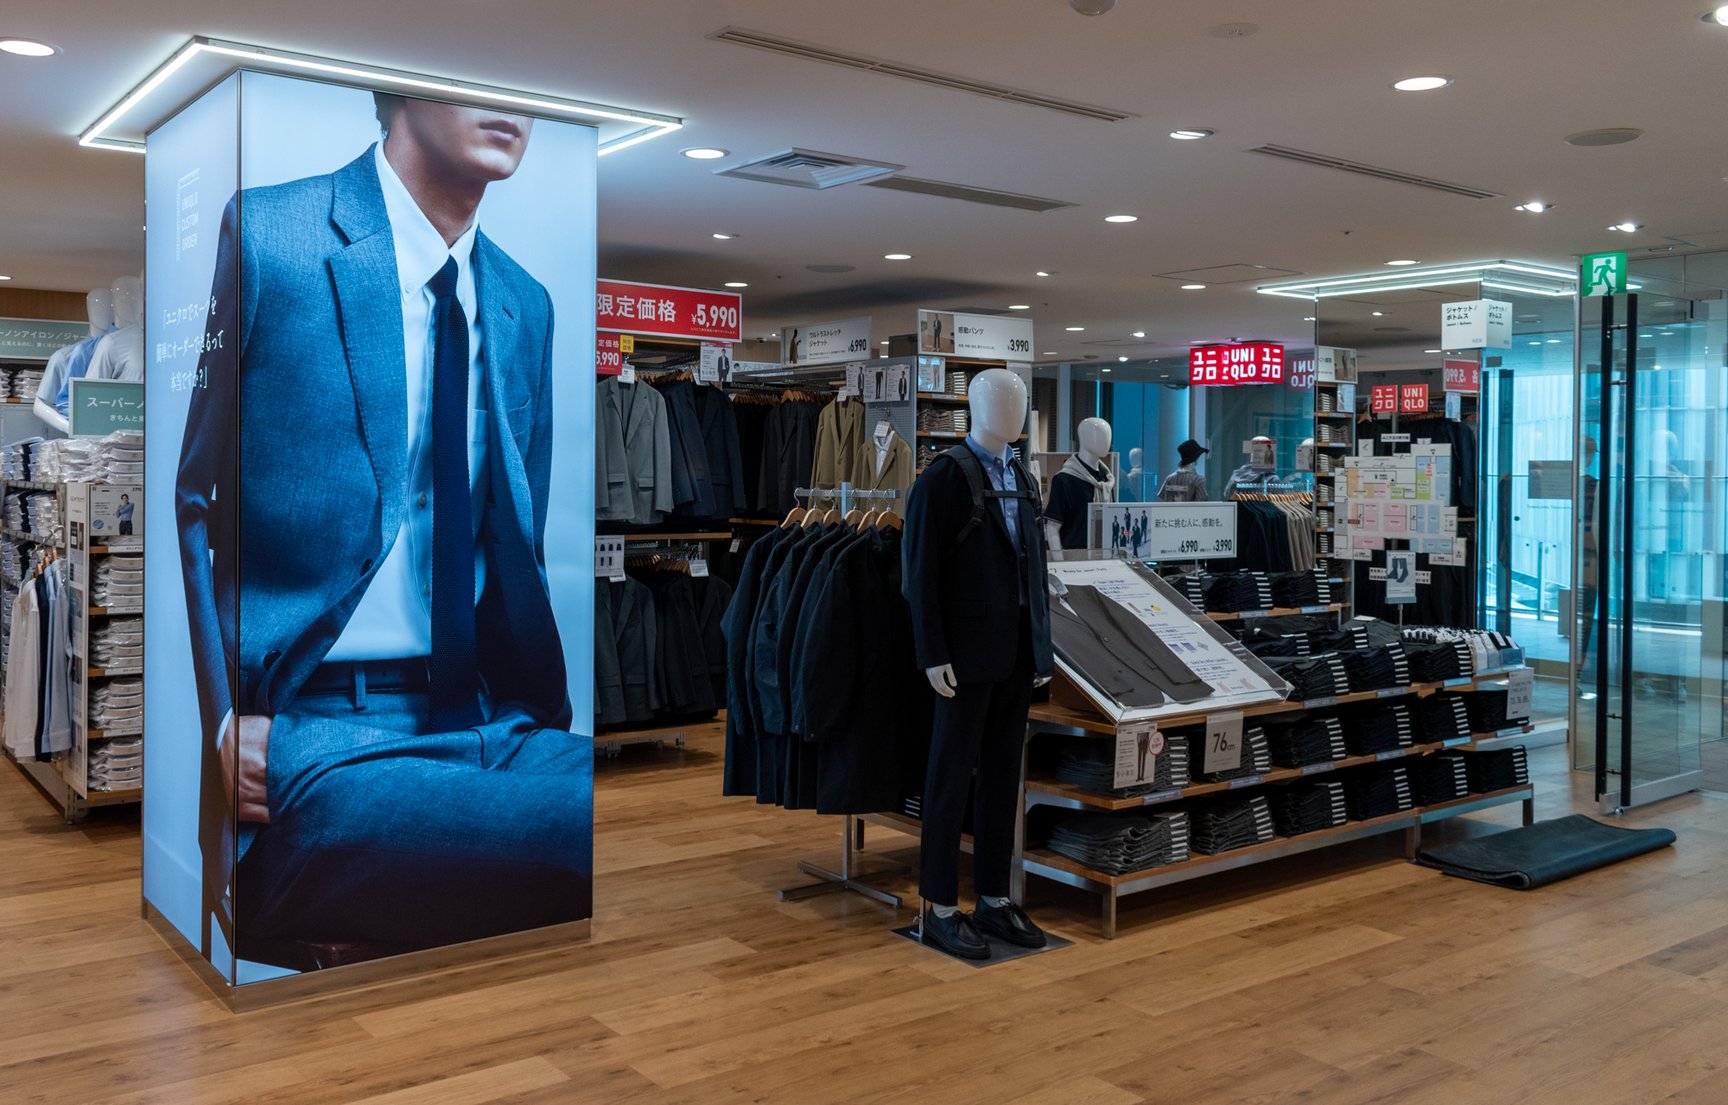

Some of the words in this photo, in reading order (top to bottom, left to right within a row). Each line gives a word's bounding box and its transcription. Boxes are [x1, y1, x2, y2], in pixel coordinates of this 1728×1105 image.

[181, 191, 199, 211] UNIQLO
[181, 212, 199, 231] CUSTOM
[181, 232, 198, 251] ORDER
[597, 294, 677, 323] 限定価格
[691, 303, 737, 328] ¥5,990
[1446, 305, 1472, 313] ジャケット
[1446, 313, 1469, 321] ボトムス
[958, 326, 984, 336] 感動パンツ
[809, 339, 828, 348] ジャケット
[1231, 347, 1255, 362] UNI
[1230, 364, 1257, 380] QLO
[1404, 387, 1423, 397] UNI
[1404, 399, 1424, 410] QLO
[1155, 517, 1223, 529] 新たに挑む人に、感動を。
